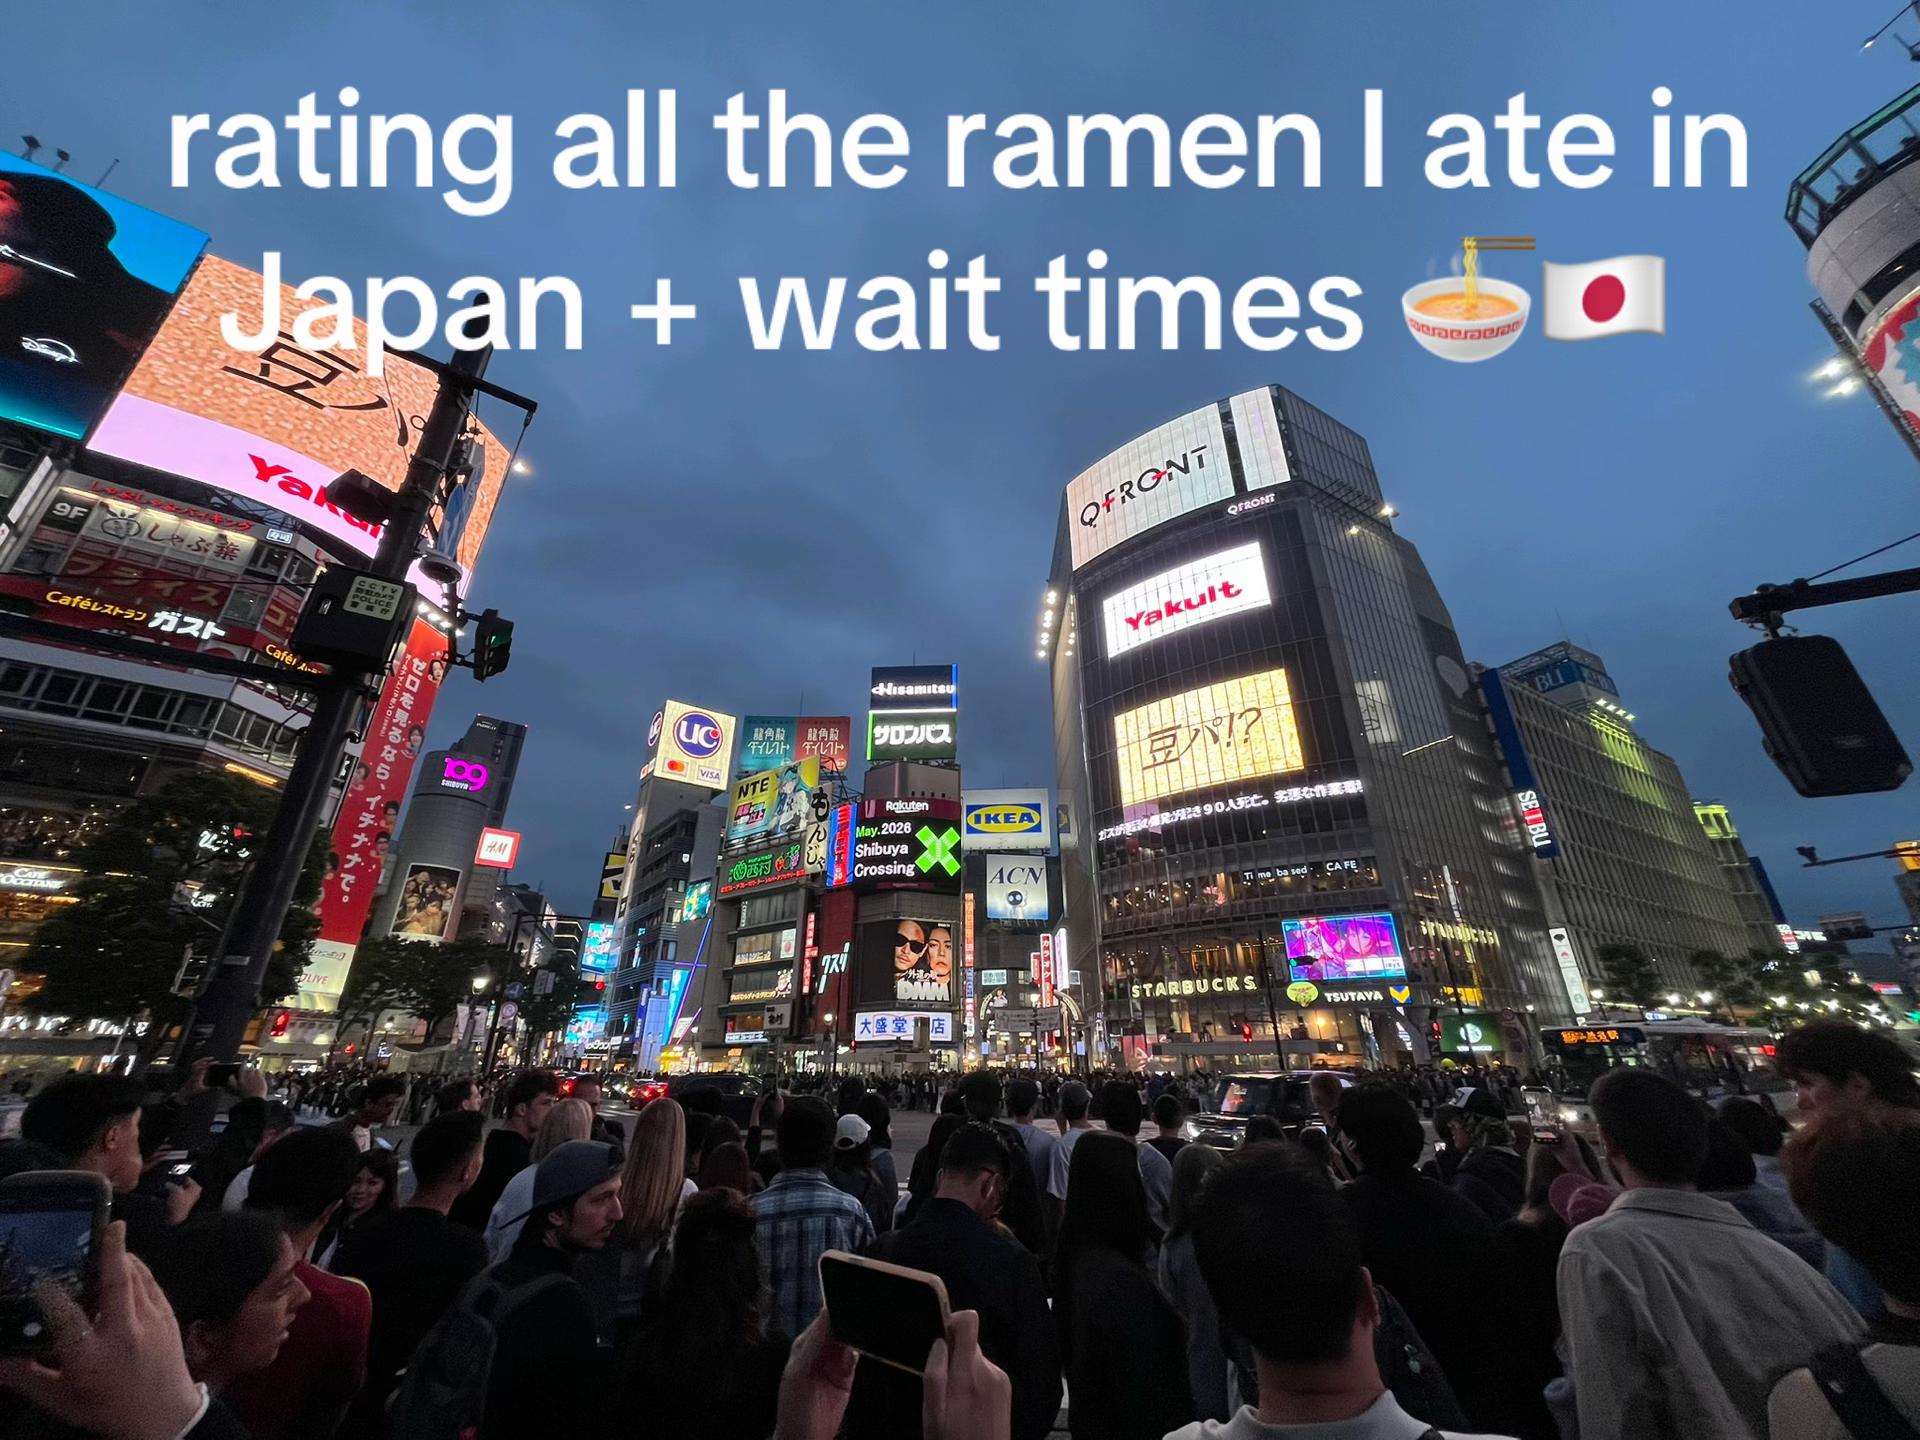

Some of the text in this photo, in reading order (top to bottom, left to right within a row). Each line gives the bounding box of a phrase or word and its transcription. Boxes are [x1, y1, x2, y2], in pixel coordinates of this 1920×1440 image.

[1080, 444, 1208, 528] QFRONT
[52, 501, 89, 520] 9F
[1226, 493, 1276, 516] QFRONT
[147, 522, 242, 561] しゃぶ葉
[357, 580, 398, 595] CCTV
[351, 593, 393, 609] POLICE
[1124, 580, 1243, 632] Yakult
[148, 610, 226, 641] ガスト
[871, 682, 956, 697] Hisamitsu
[679, 720, 719, 749] UC
[873, 723, 952, 746] サロンパス
[443, 757, 489, 793] 109
[700, 769, 721, 780] VISA
[441, 778, 469, 791] SHIBUYA
[737, 776, 771, 801] NTE
[885, 800, 930, 813] Rakuten
[973, 812, 1035, 825] IKEA
[805, 786, 829, 872] もんじゃ
[854, 840, 909, 859] Shibuya
[853, 861, 916, 879] Crossing
[989, 866, 1045, 885] ACN
[896, 978, 950, 1001] DMM
[1131, 975, 1258, 999] STARBUCKS
[1324, 990, 1384, 1003] TSUTAYA
[860, 1016, 945, 1035] 大盛堂店
